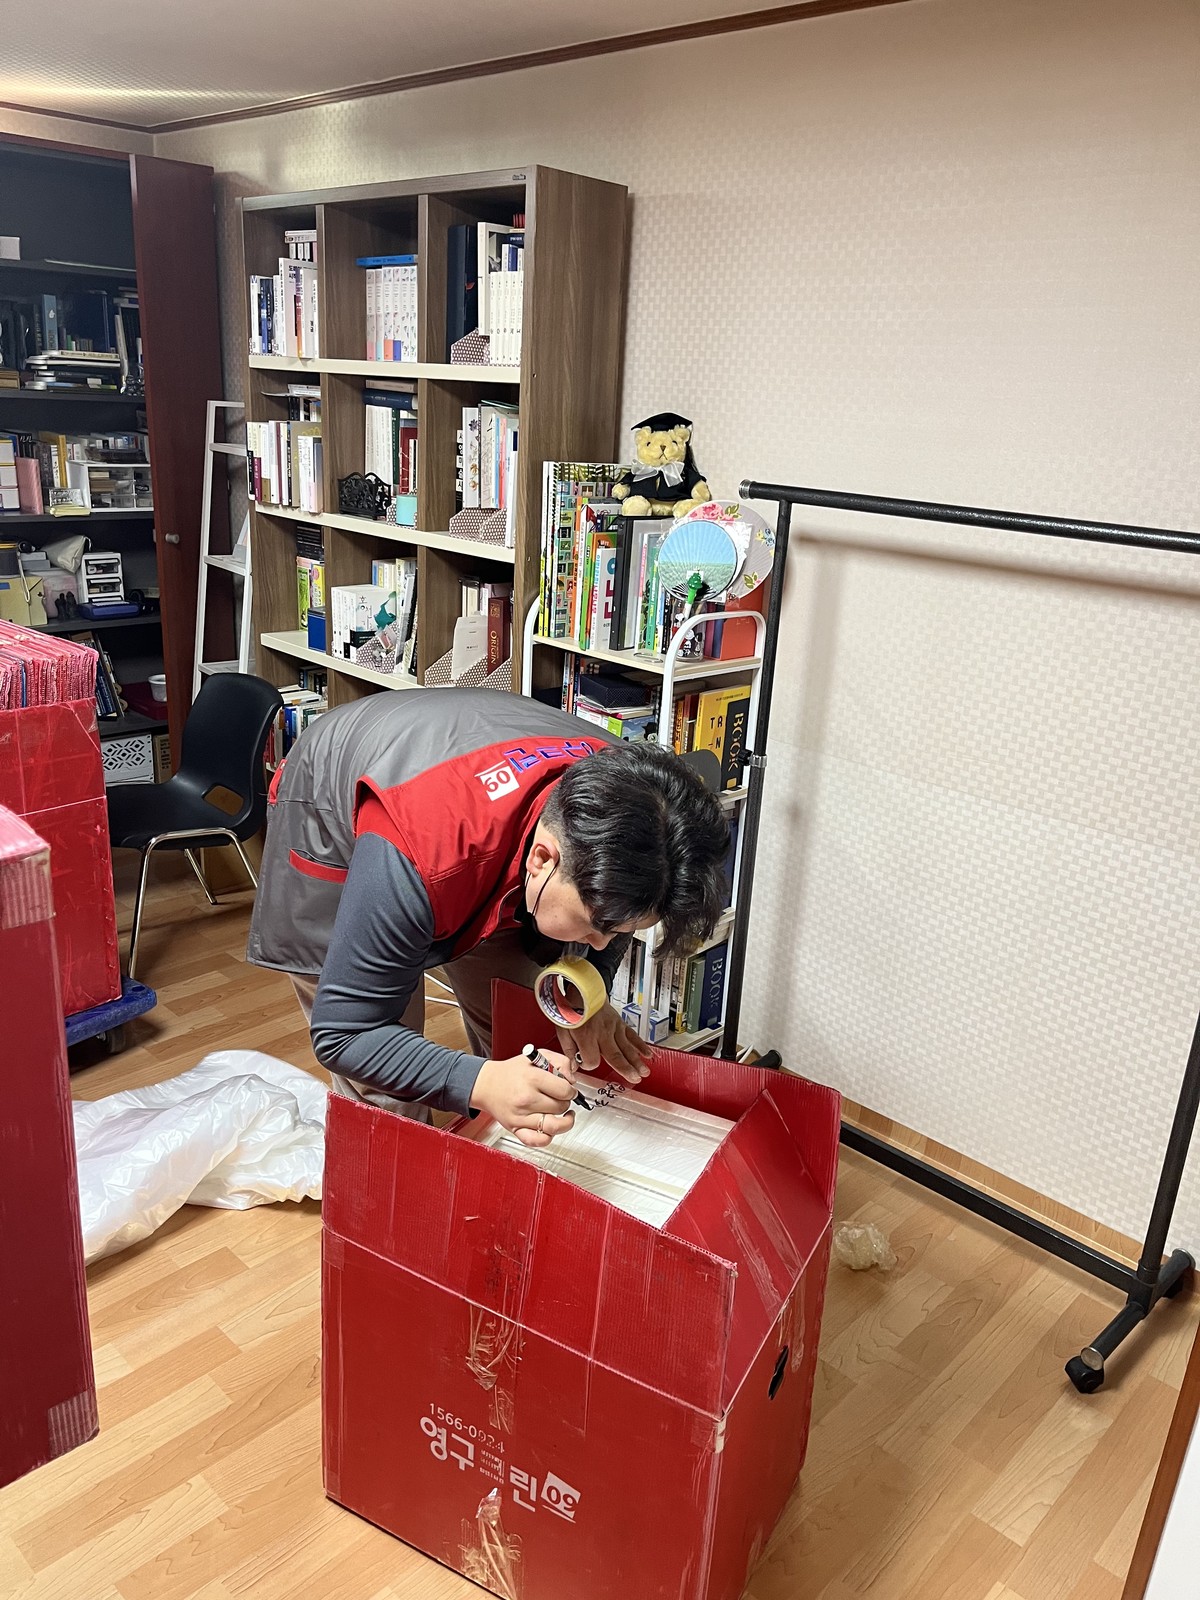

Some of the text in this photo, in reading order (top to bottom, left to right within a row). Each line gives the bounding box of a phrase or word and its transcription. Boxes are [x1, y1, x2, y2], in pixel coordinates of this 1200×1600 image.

[489, 630, 498, 665] ORIGIN
[504, 741, 595, 774] 구크린
[727, 712, 745, 772] BOOK
[709, 956, 725, 1009] BOOK
[429, 1402, 505, 1454] 1566-0924
